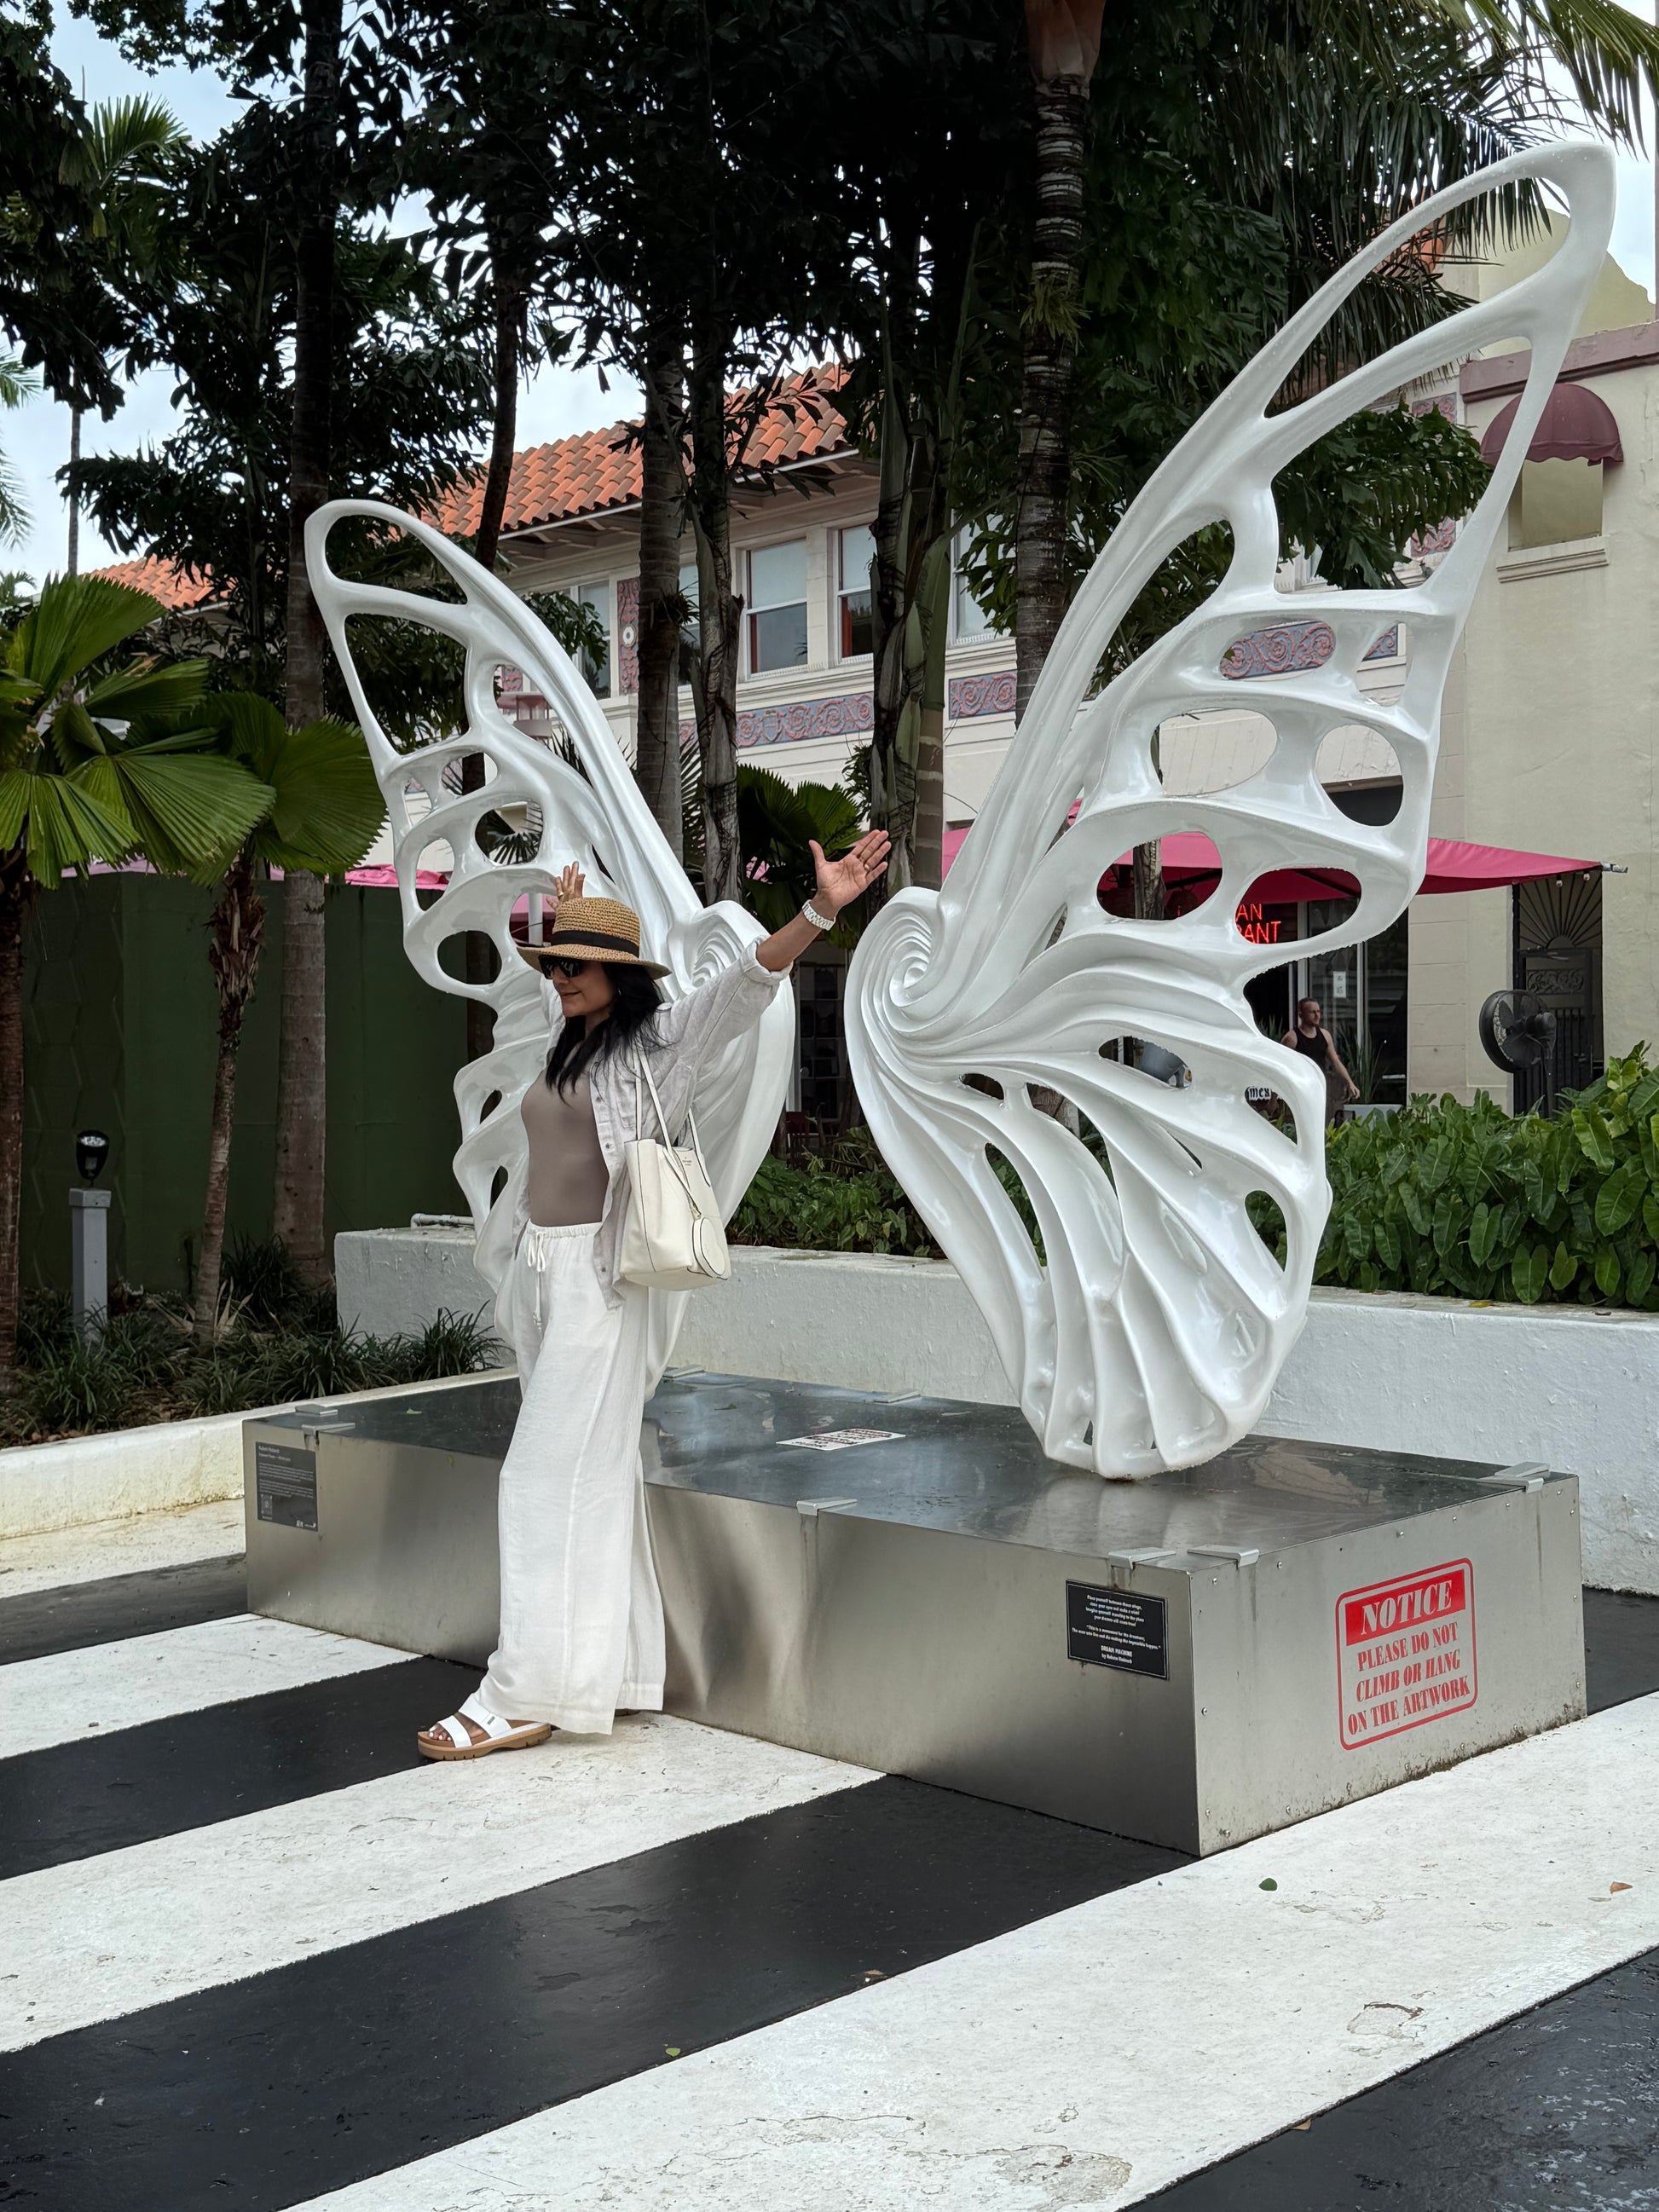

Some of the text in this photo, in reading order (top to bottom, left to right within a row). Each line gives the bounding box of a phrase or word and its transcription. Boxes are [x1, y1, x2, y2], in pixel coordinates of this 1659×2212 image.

[1361, 1580, 1453, 1636] NOTICE
[1357, 1622, 1459, 1672] PLEASE DO NOT
[1356, 1649, 1461, 1702] CLIMB OR HANG
[1348, 1675, 1471, 1735] ON THE ARTWORK
